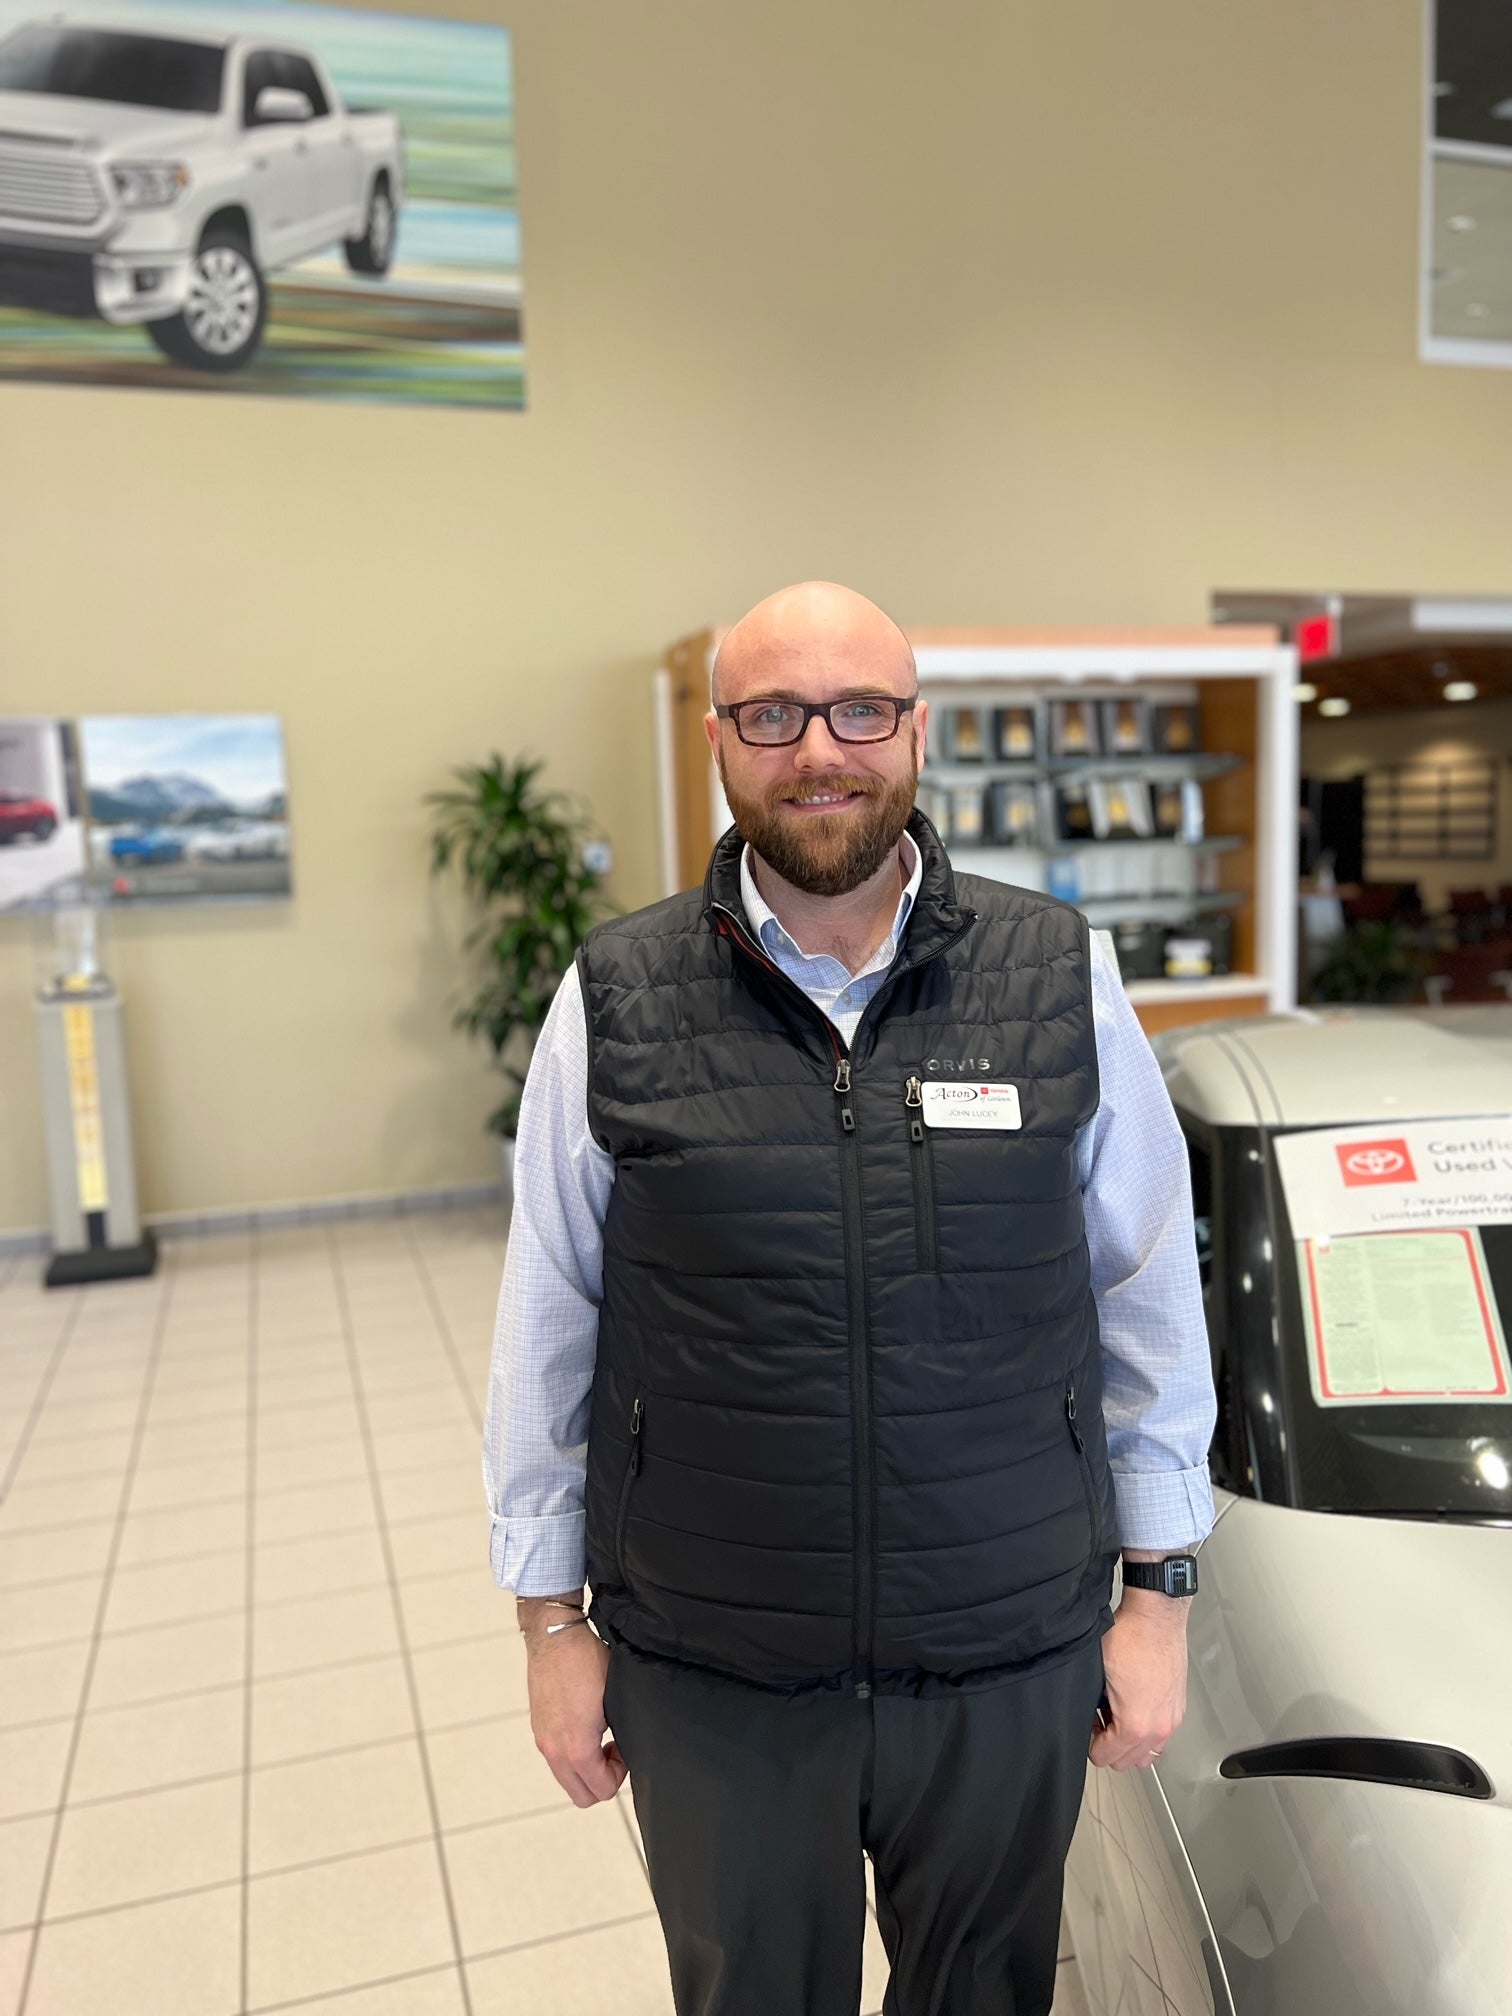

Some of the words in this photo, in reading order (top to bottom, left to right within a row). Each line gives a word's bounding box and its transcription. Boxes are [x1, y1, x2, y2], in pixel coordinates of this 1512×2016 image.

[926, 1058, 991, 1072] ORVIS
[930, 1087, 970, 1100] Acton
[948, 1109, 970, 1117] JOHN
[972, 1110, 998, 1118] LUCEY
[1433, 1158, 1497, 1174] Used
